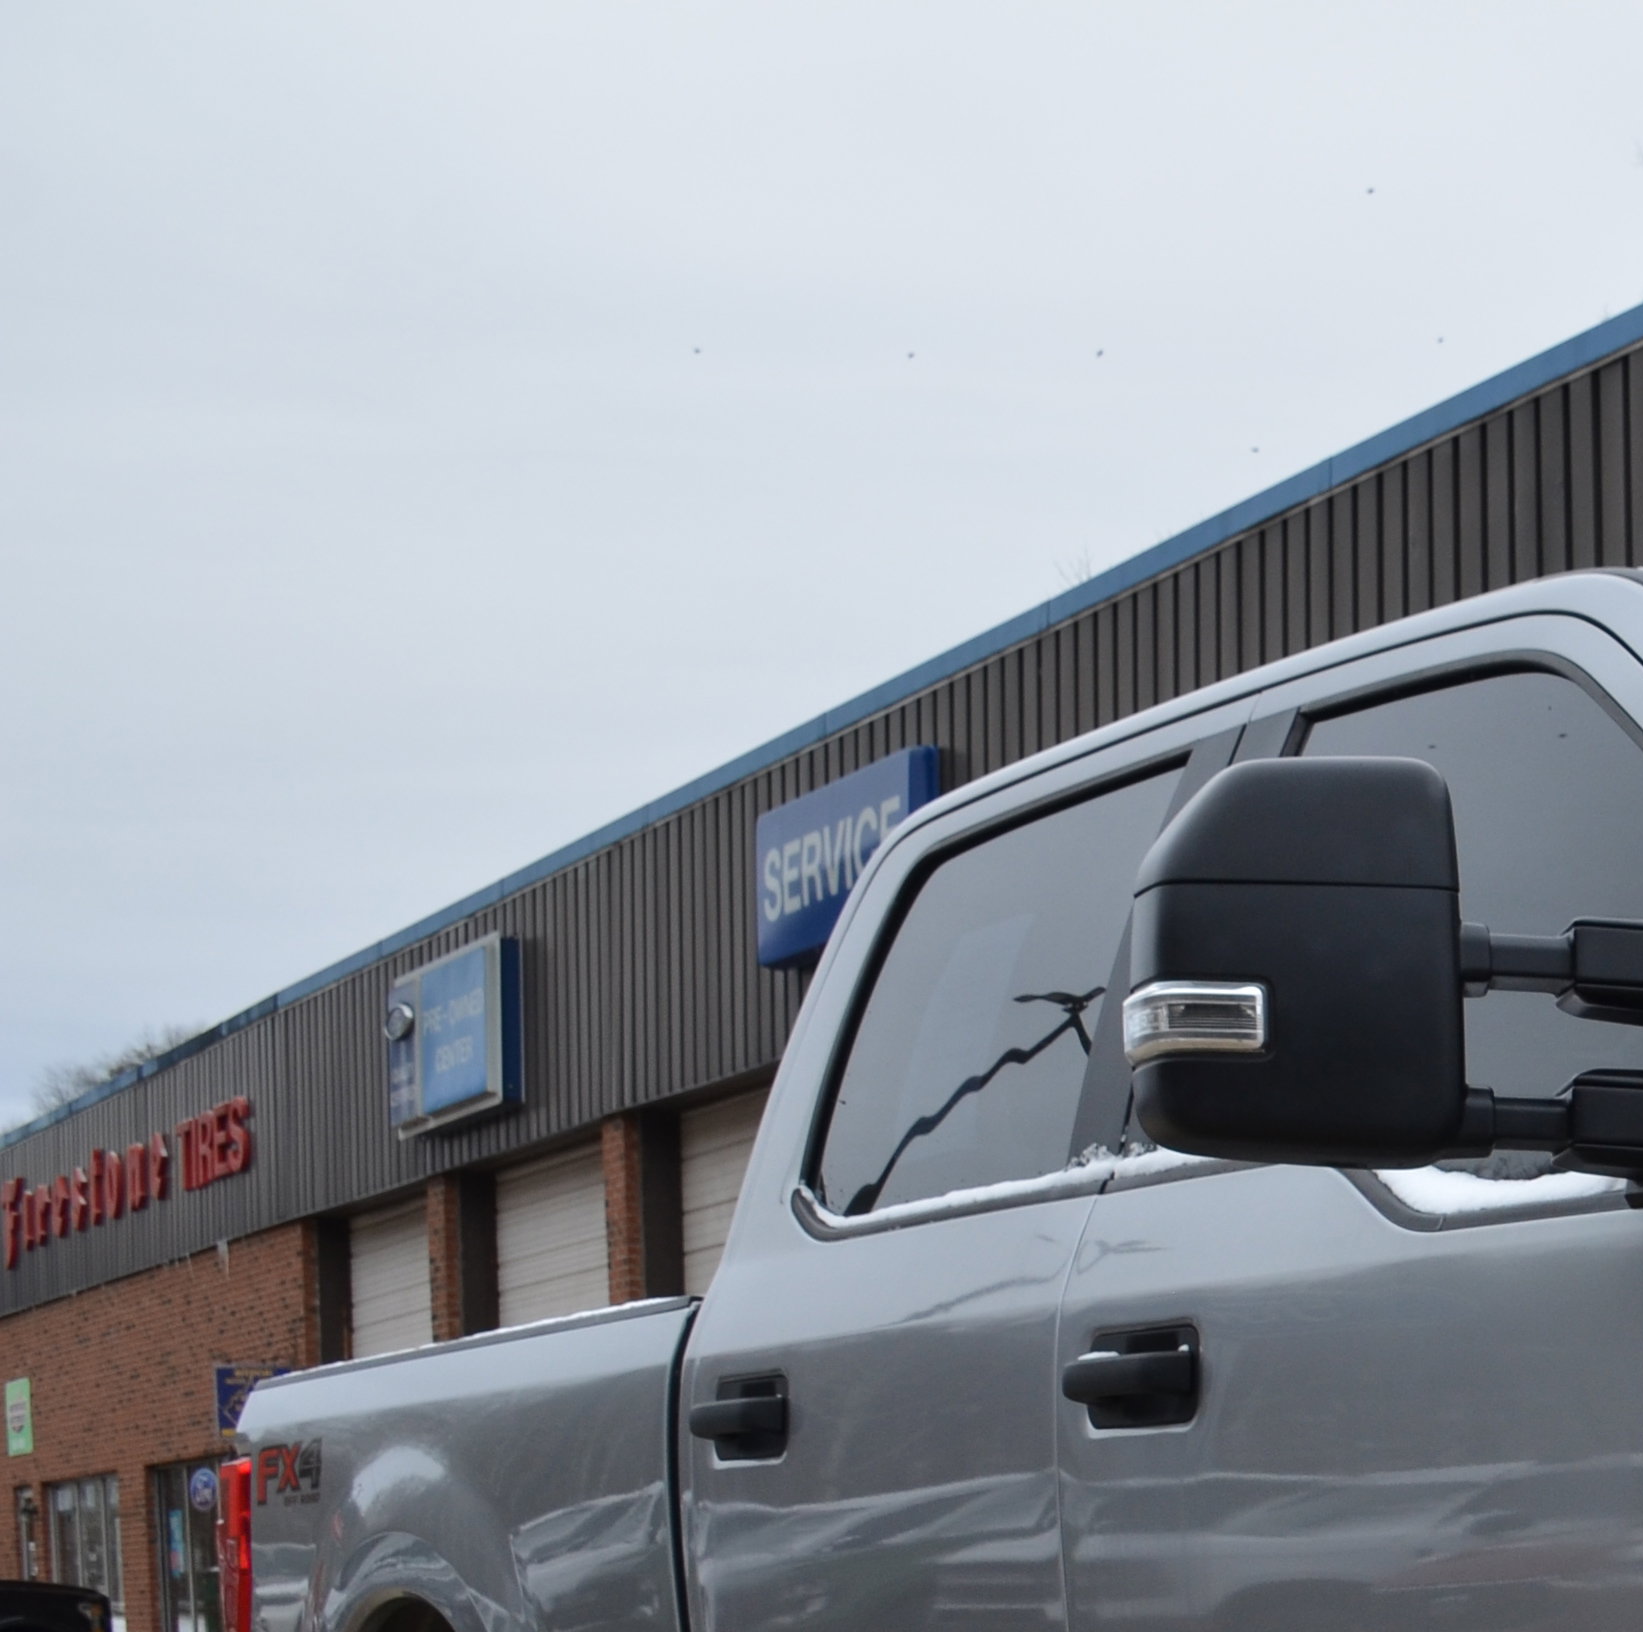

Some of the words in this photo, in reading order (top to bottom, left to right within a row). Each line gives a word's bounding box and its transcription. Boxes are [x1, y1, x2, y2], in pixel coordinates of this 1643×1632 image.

[3, 1131, 169, 1272] Firestone
[175, 1096, 254, 1192] TIRES
[256, 1436, 323, 1507] FX4
